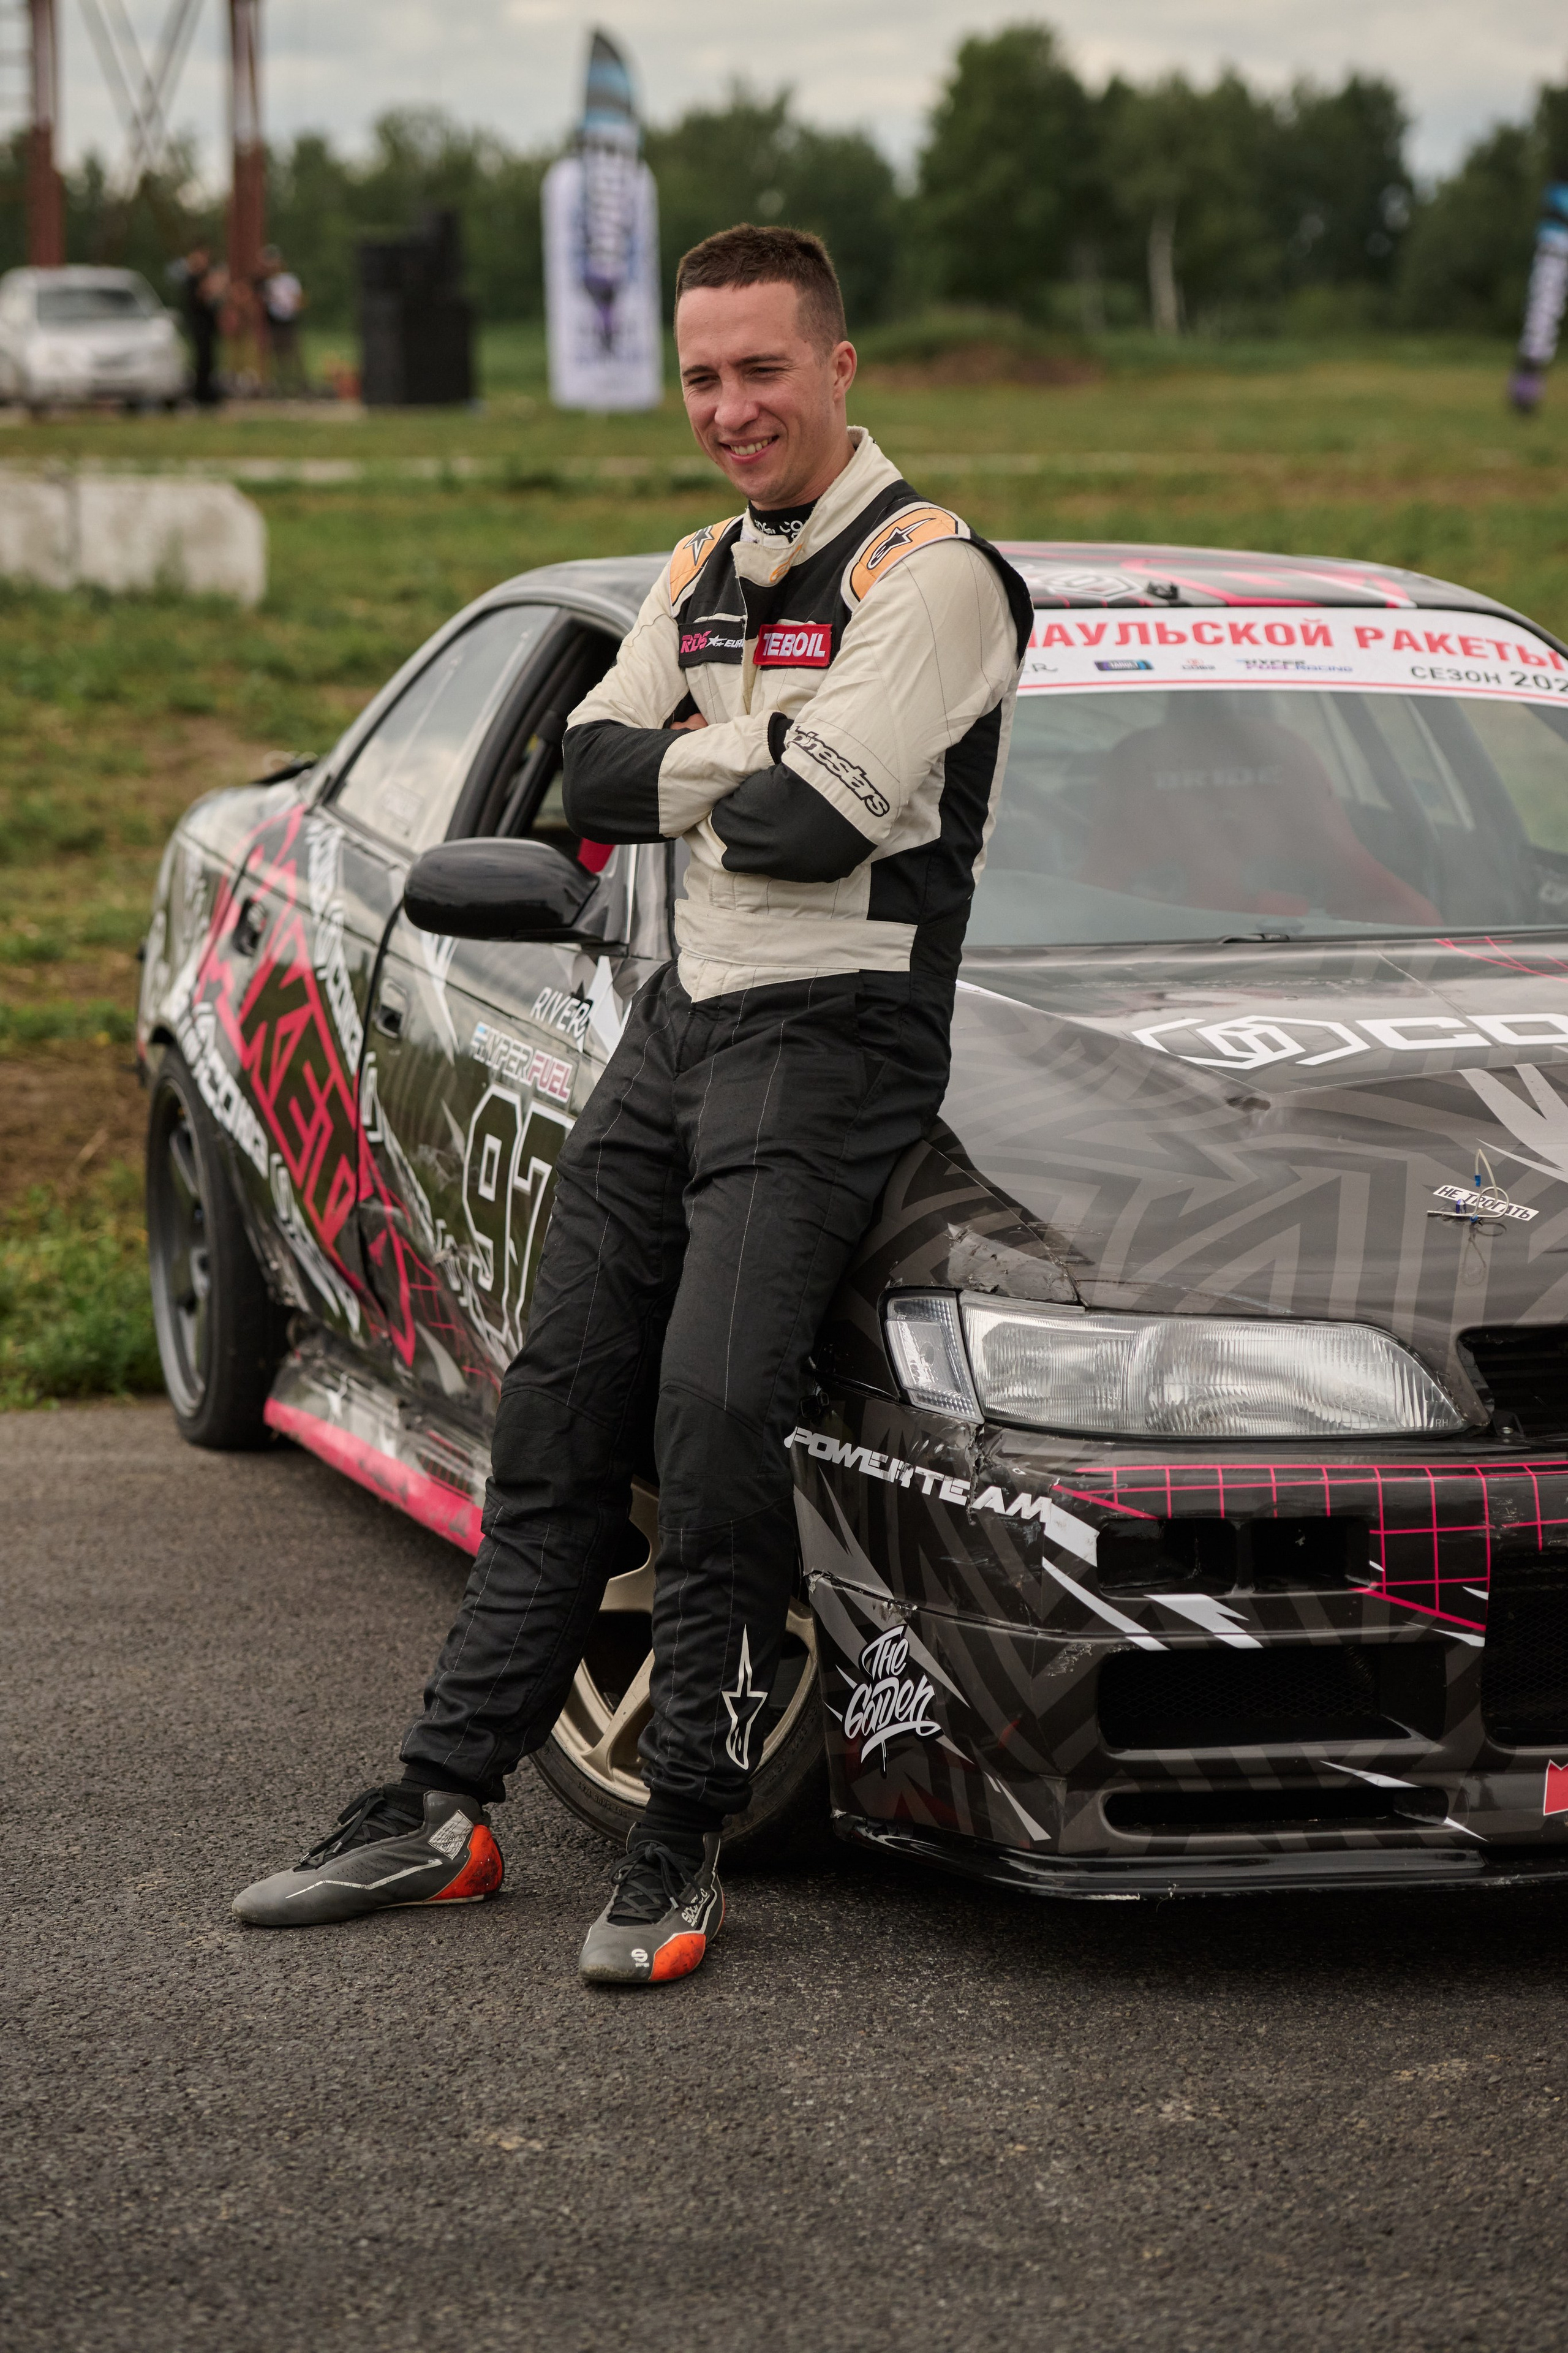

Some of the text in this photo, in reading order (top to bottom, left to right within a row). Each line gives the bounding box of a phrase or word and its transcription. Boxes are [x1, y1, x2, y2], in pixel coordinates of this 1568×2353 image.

[763, 632, 826, 657] TEBOIL
[1354, 625, 1566, 671] РАКЕТЫ
[1411, 665, 1502, 684] СЕЗОН
[462, 1083, 578, 1351] 97
[1438, 1186, 1531, 1219] НЕ ТРОГАТЬ
[1434, 1418, 1449, 1427] RH
